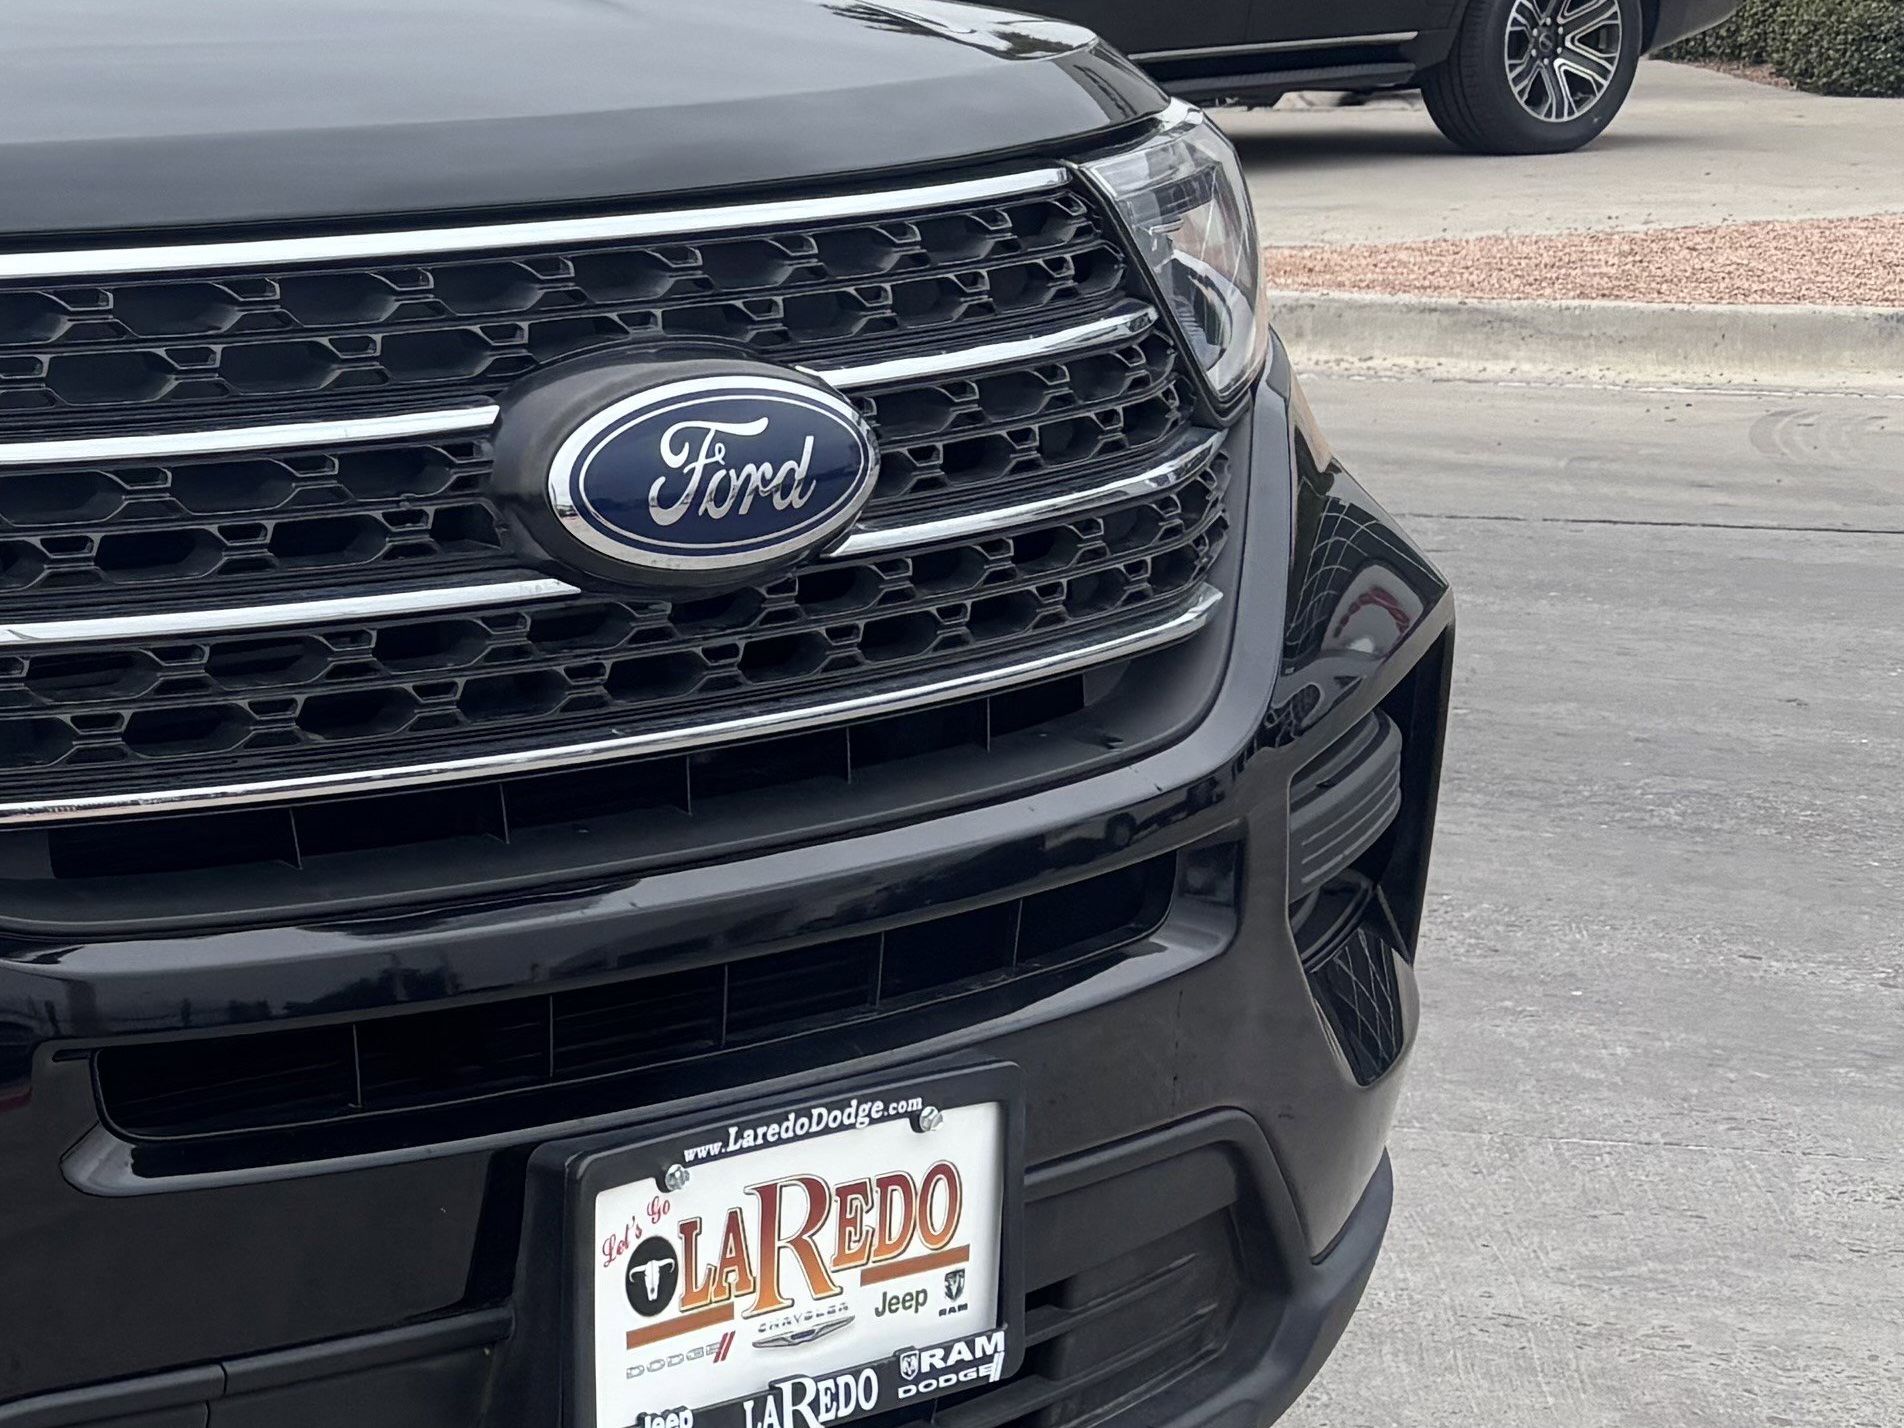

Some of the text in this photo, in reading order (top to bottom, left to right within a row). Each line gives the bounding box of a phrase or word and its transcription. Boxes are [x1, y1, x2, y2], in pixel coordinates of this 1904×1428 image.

[647, 416, 817, 526] Ford
[683, 1096, 923, 1163] www.LaredoDodge.com
[602, 1195, 671, 1268] Let's Go
[678, 1159, 962, 1320] LAREDO
[757, 1302, 850, 1334] CHRYSLER
[874, 1287, 929, 1318] Jeep
[938, 1302, 969, 1318] RAM
[625, 1340, 722, 1380] DODGE
[920, 1330, 1006, 1373] RAM
[897, 1362, 994, 1400] DODGE
